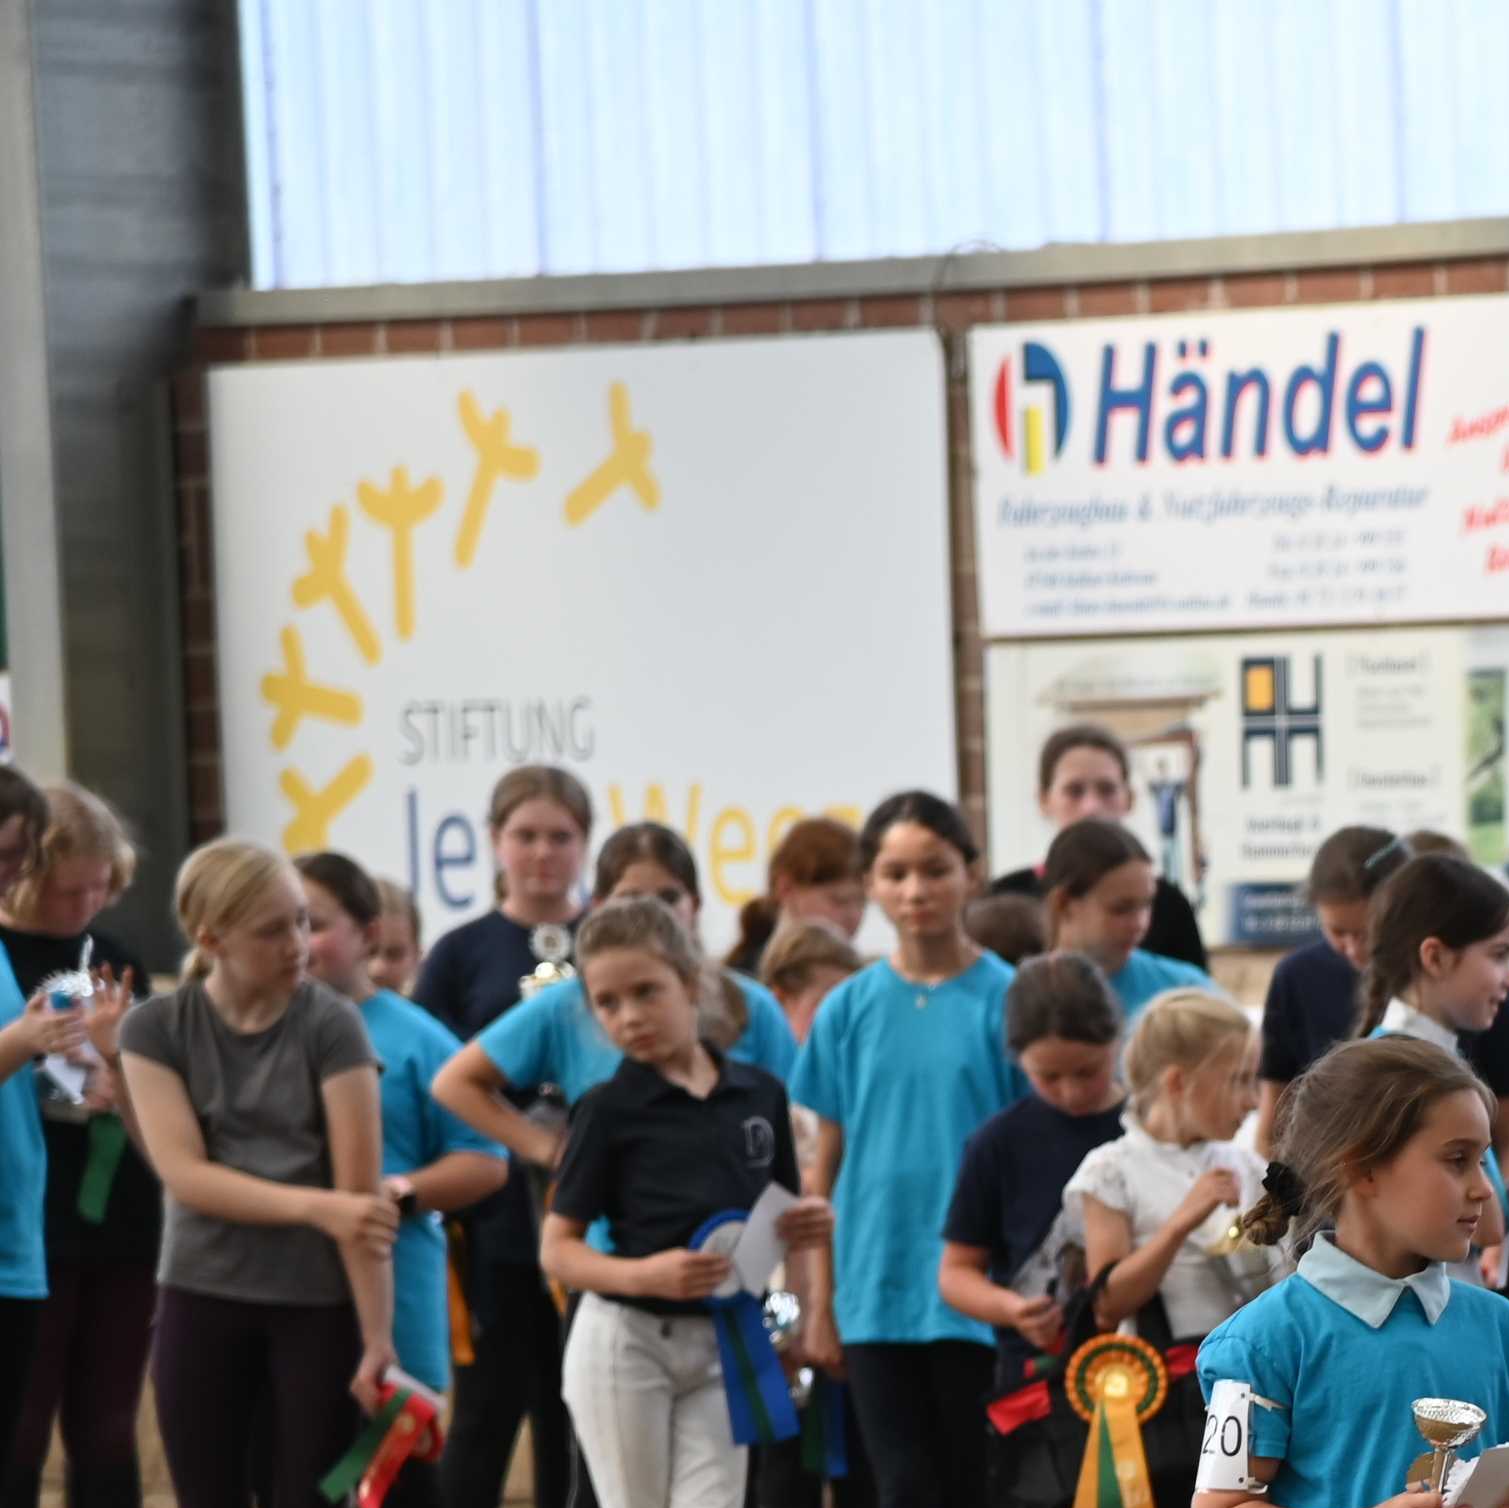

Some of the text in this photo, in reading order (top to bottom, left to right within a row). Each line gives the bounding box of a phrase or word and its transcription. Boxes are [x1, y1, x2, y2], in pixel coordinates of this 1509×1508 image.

[1093, 325, 1427, 466] Händel
[400, 695, 594, 765] STIFTUNG
[1202, 1414, 1243, 1457] 20
